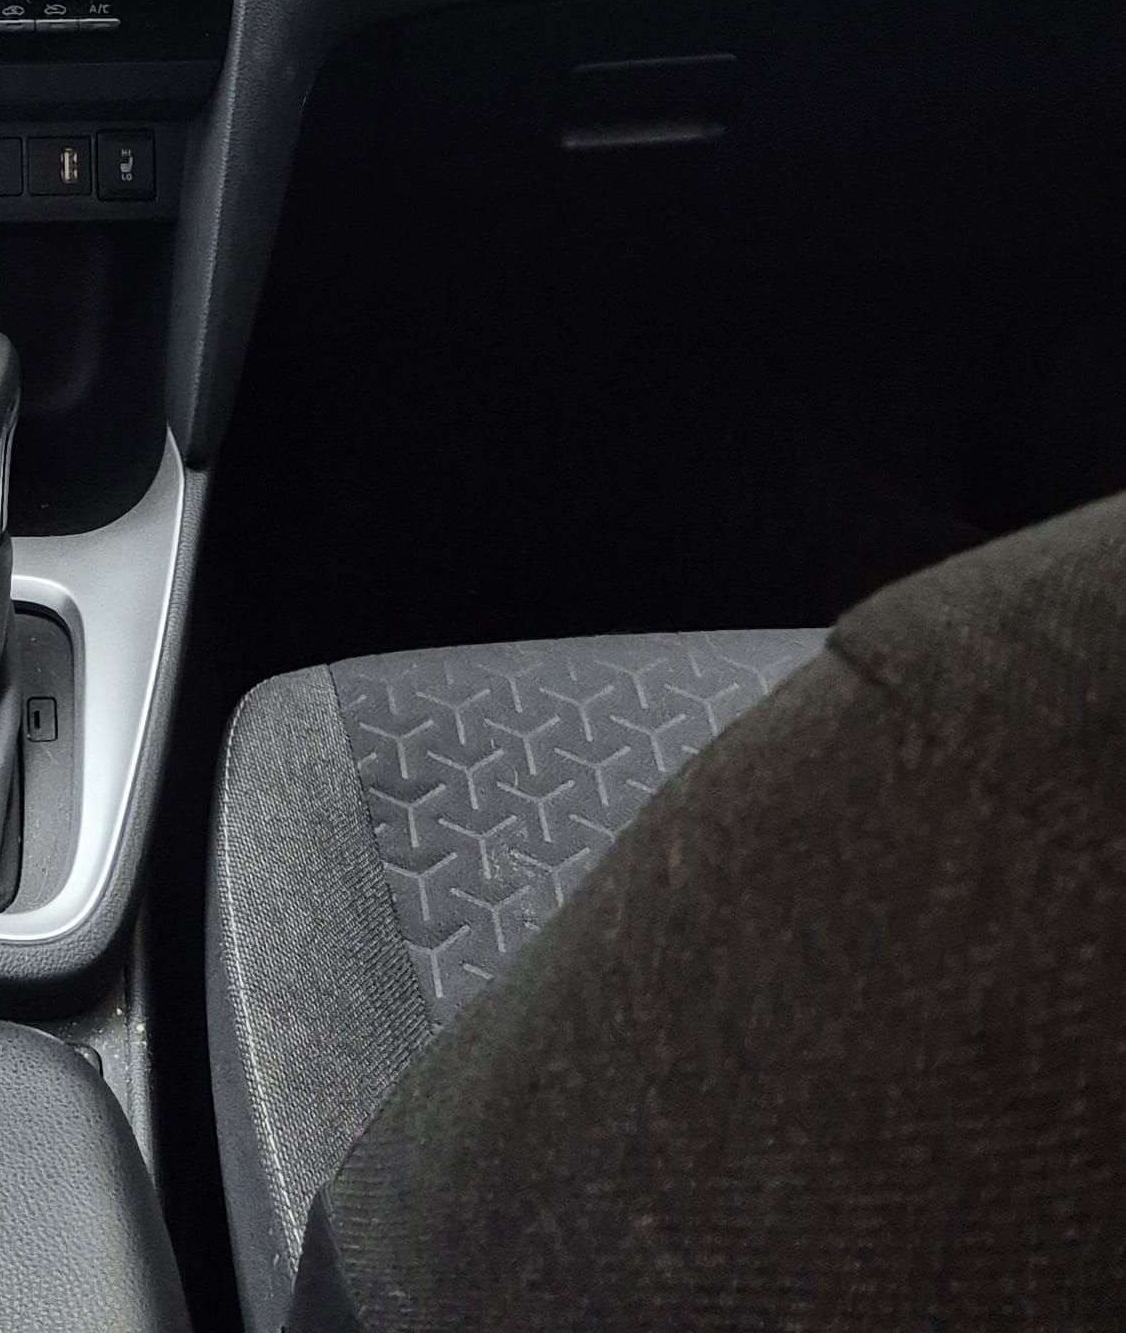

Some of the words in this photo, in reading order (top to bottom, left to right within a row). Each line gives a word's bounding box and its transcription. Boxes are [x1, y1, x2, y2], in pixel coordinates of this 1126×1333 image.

[89, 4, 110, 14] A/C
[121, 149, 131, 157] HI
[121, 173, 133, 181] LO
